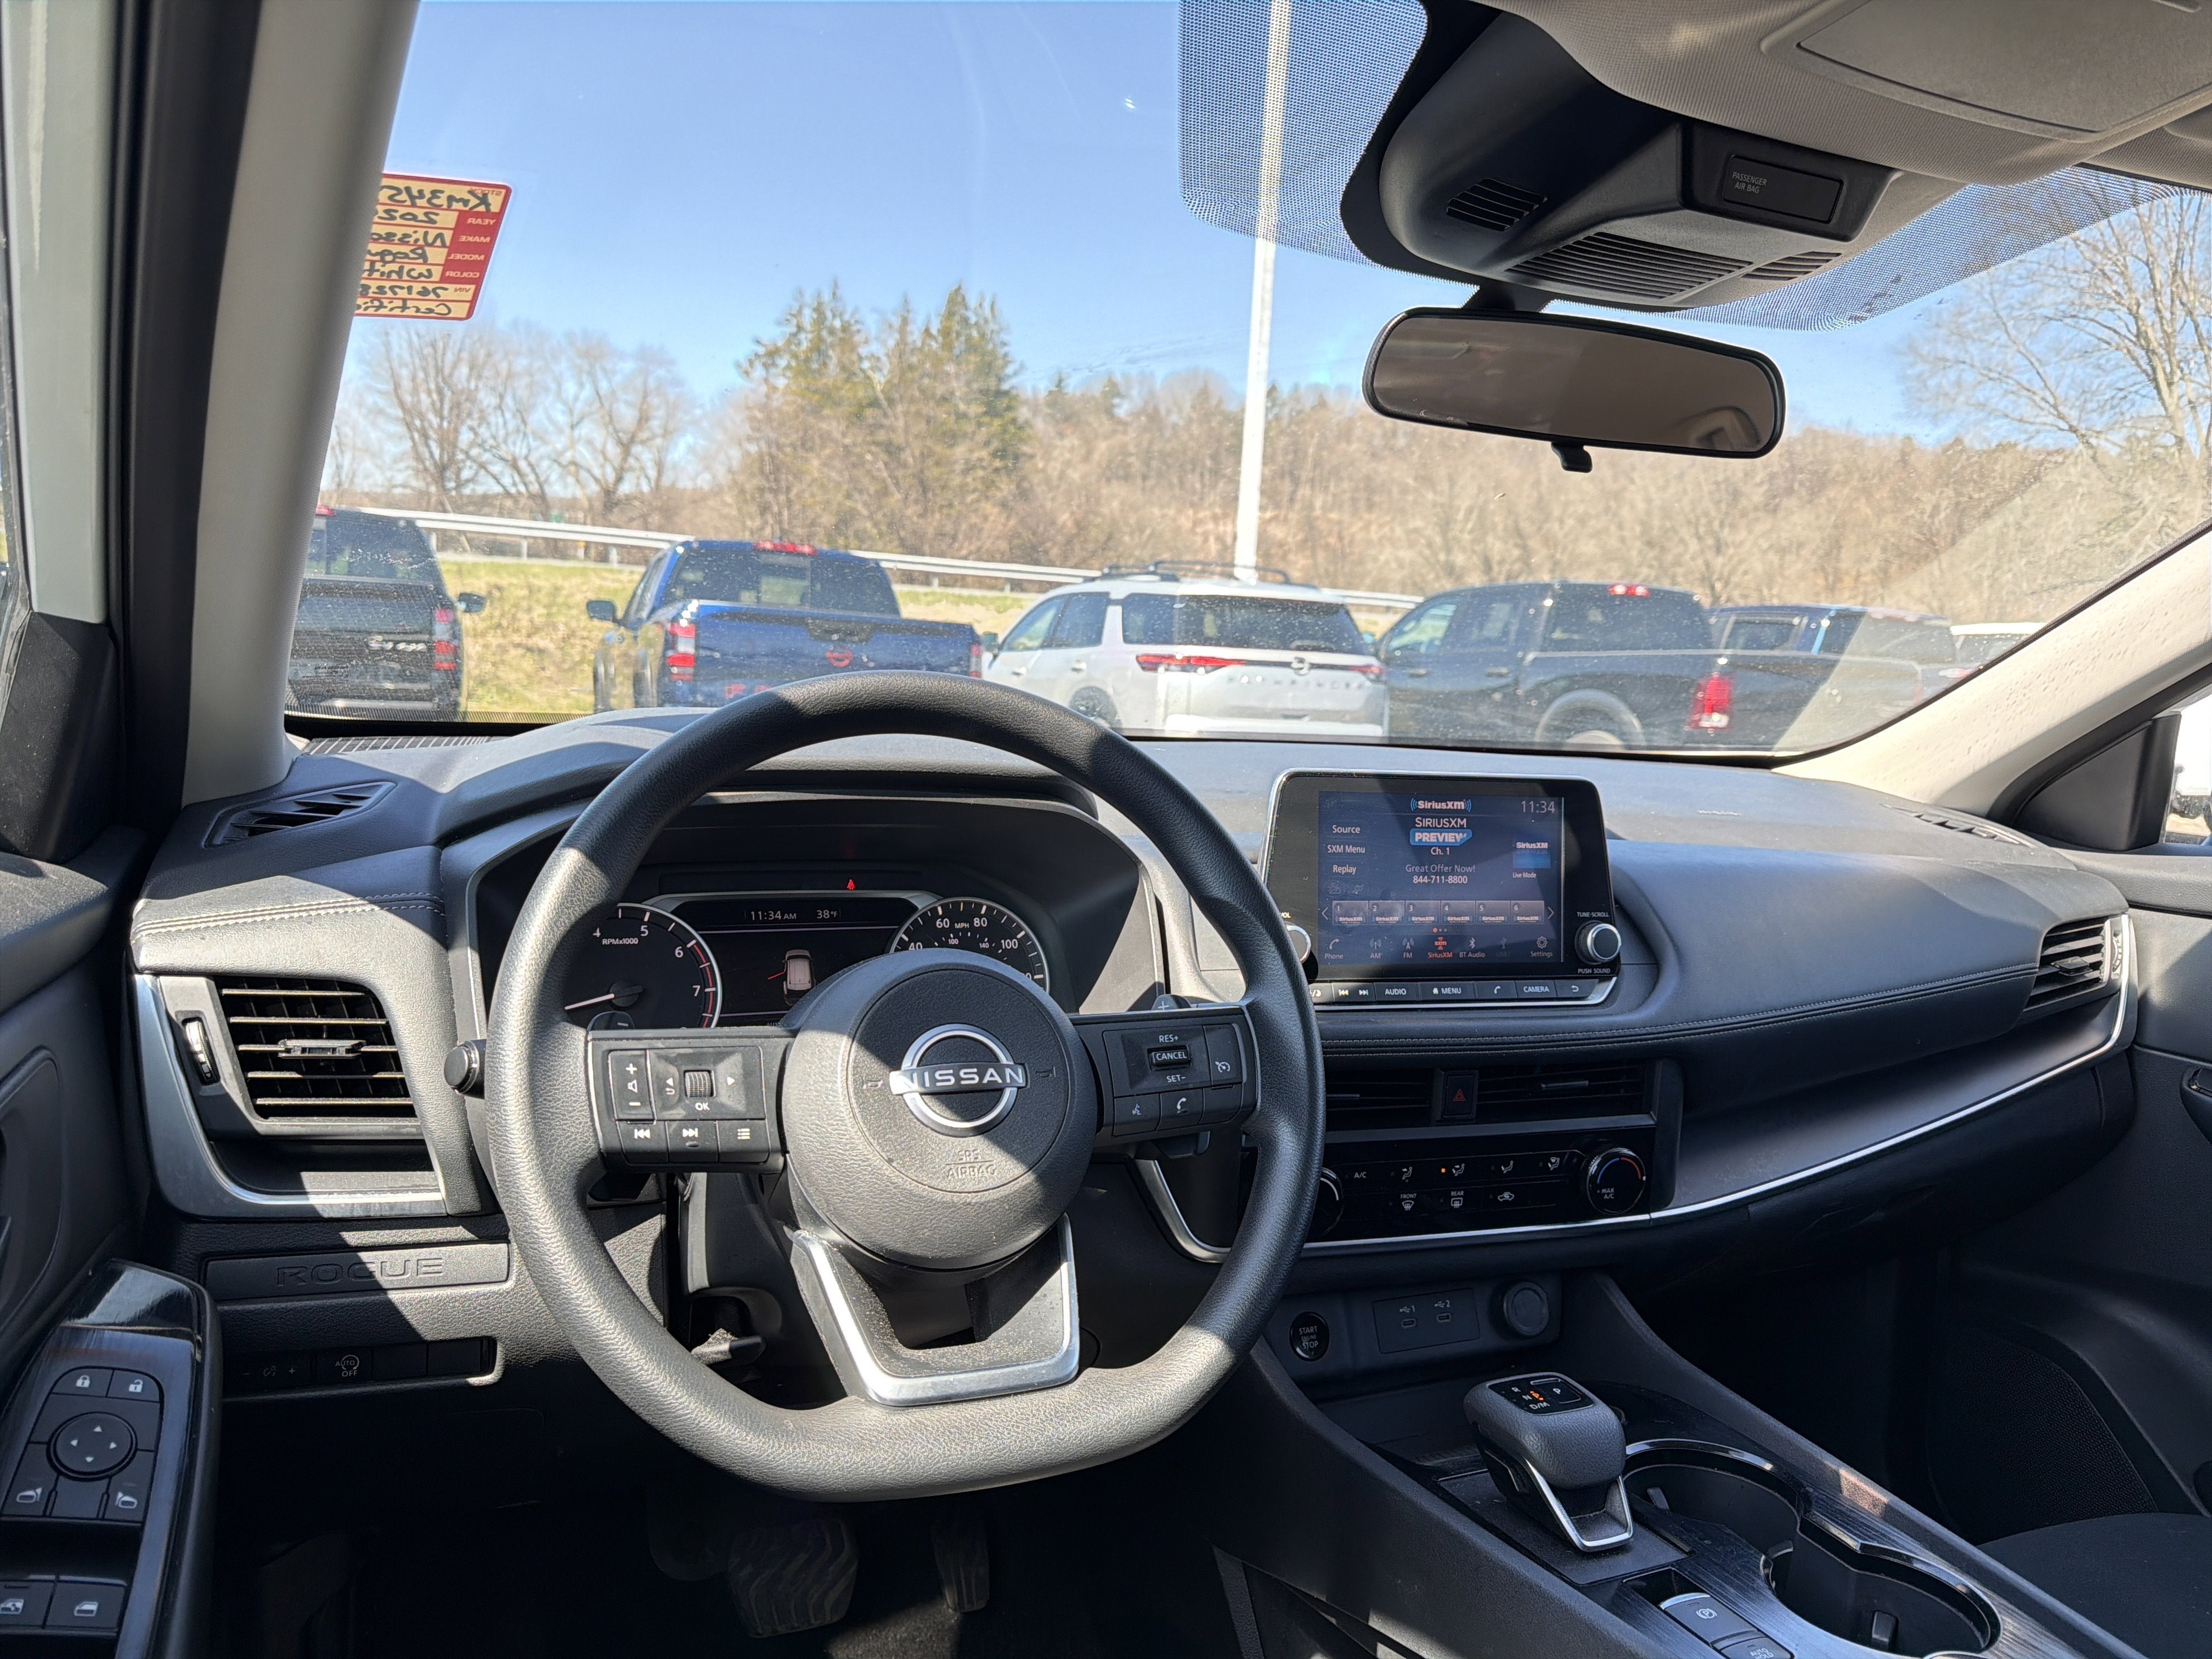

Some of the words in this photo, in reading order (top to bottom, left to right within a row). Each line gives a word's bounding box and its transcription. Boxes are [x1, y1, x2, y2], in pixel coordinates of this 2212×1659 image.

[1732, 171, 1768, 186] PASSENGER
[1734, 182, 1745, 191] AIR
[1746, 184, 1759, 194] BAG
[1521, 800, 1555, 814] 11:34
[1415, 816, 1467, 828] SIRIUSXM
[1331, 825, 1361, 834] Source
[1414, 832, 1468, 843] PREVIEW
[1327, 844, 1344, 854] SXM
[1345, 844, 1366, 854] Menu
[1430, 847, 1444, 855] Ch.
[1446, 847, 1450, 855] 1
[1333, 864, 1357, 876] Replay
[1405, 864, 1429, 873] Great
[1430, 864, 1453, 873] Offer
[1454, 864, 1476, 873] Now!
[1413, 876, 1468, 884] 844-711-8800
[751, 910, 782, 922] 11:34
[936, 918, 950, 929] 60
[973, 917, 988, 928] 80
[592, 927, 601, 938] 4
[640, 925, 649, 937] 5
[909, 942, 923, 951] 40
[948, 938, 960, 946] 100
[1001, 939, 1019, 950] 100
[674, 946, 684, 958] 6
[1530, 950, 1553, 959] Settings
[692, 984, 701, 997] 7
[1159, 1034, 1179, 1043] RES+
[1156, 1051, 1188, 1061] CANCEL
[900, 1068, 1024, 1089] NISSAN
[1166, 1075, 1187, 1083] SET-
[695, 1102, 710, 1111] OK
[957, 1149, 983, 1161] SRS
[947, 1164, 998, 1181] AIRBAG
[276, 1256, 445, 1286] ROGUE
[1410, 1305, 1415, 1313] 1
[1445, 1300, 1451, 1308] 2
[1299, 1325, 1318, 1335] START
[1302, 1340, 1319, 1350] STOP
[1528, 1401, 1551, 1410] D/M
[1750, 1647, 1769, 1657] AUTO
